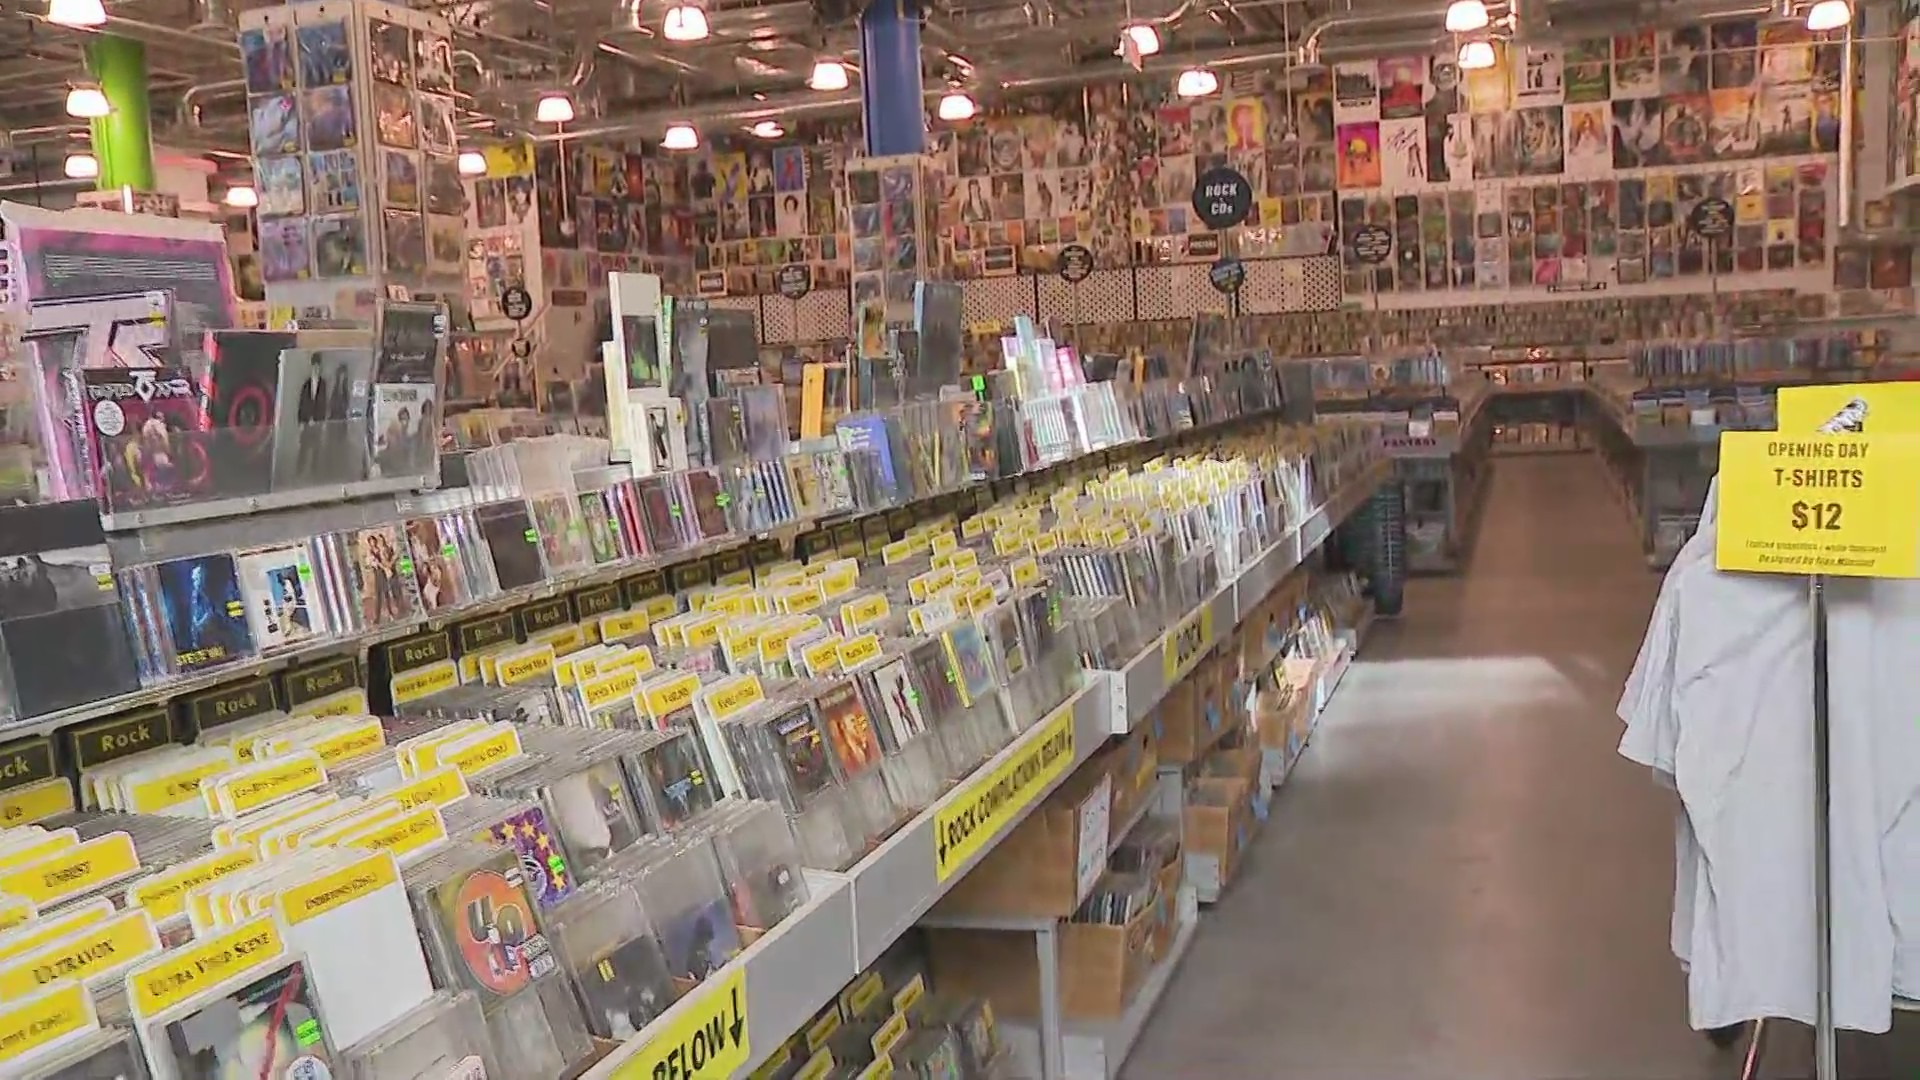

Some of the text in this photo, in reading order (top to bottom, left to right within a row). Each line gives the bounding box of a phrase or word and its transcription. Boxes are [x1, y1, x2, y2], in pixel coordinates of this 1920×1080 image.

[1205, 183, 1238, 198] ROCK
[1211, 203, 1233, 216] CDs
[1768, 442, 1869, 459] OPENING DAY
[1774, 468, 1864, 489] T-SHIRTS
[1791, 499, 1843, 531] $12
[1758, 554, 1802, 564] Designed
[405, 642, 437, 662] Rock
[306, 670, 344, 692] Rock
[215, 693, 258, 717] Rock
[102, 722, 151, 752] Rock
[948, 804, 976, 849] ROCK
[31, 939, 115, 984] ULTRAVOX
